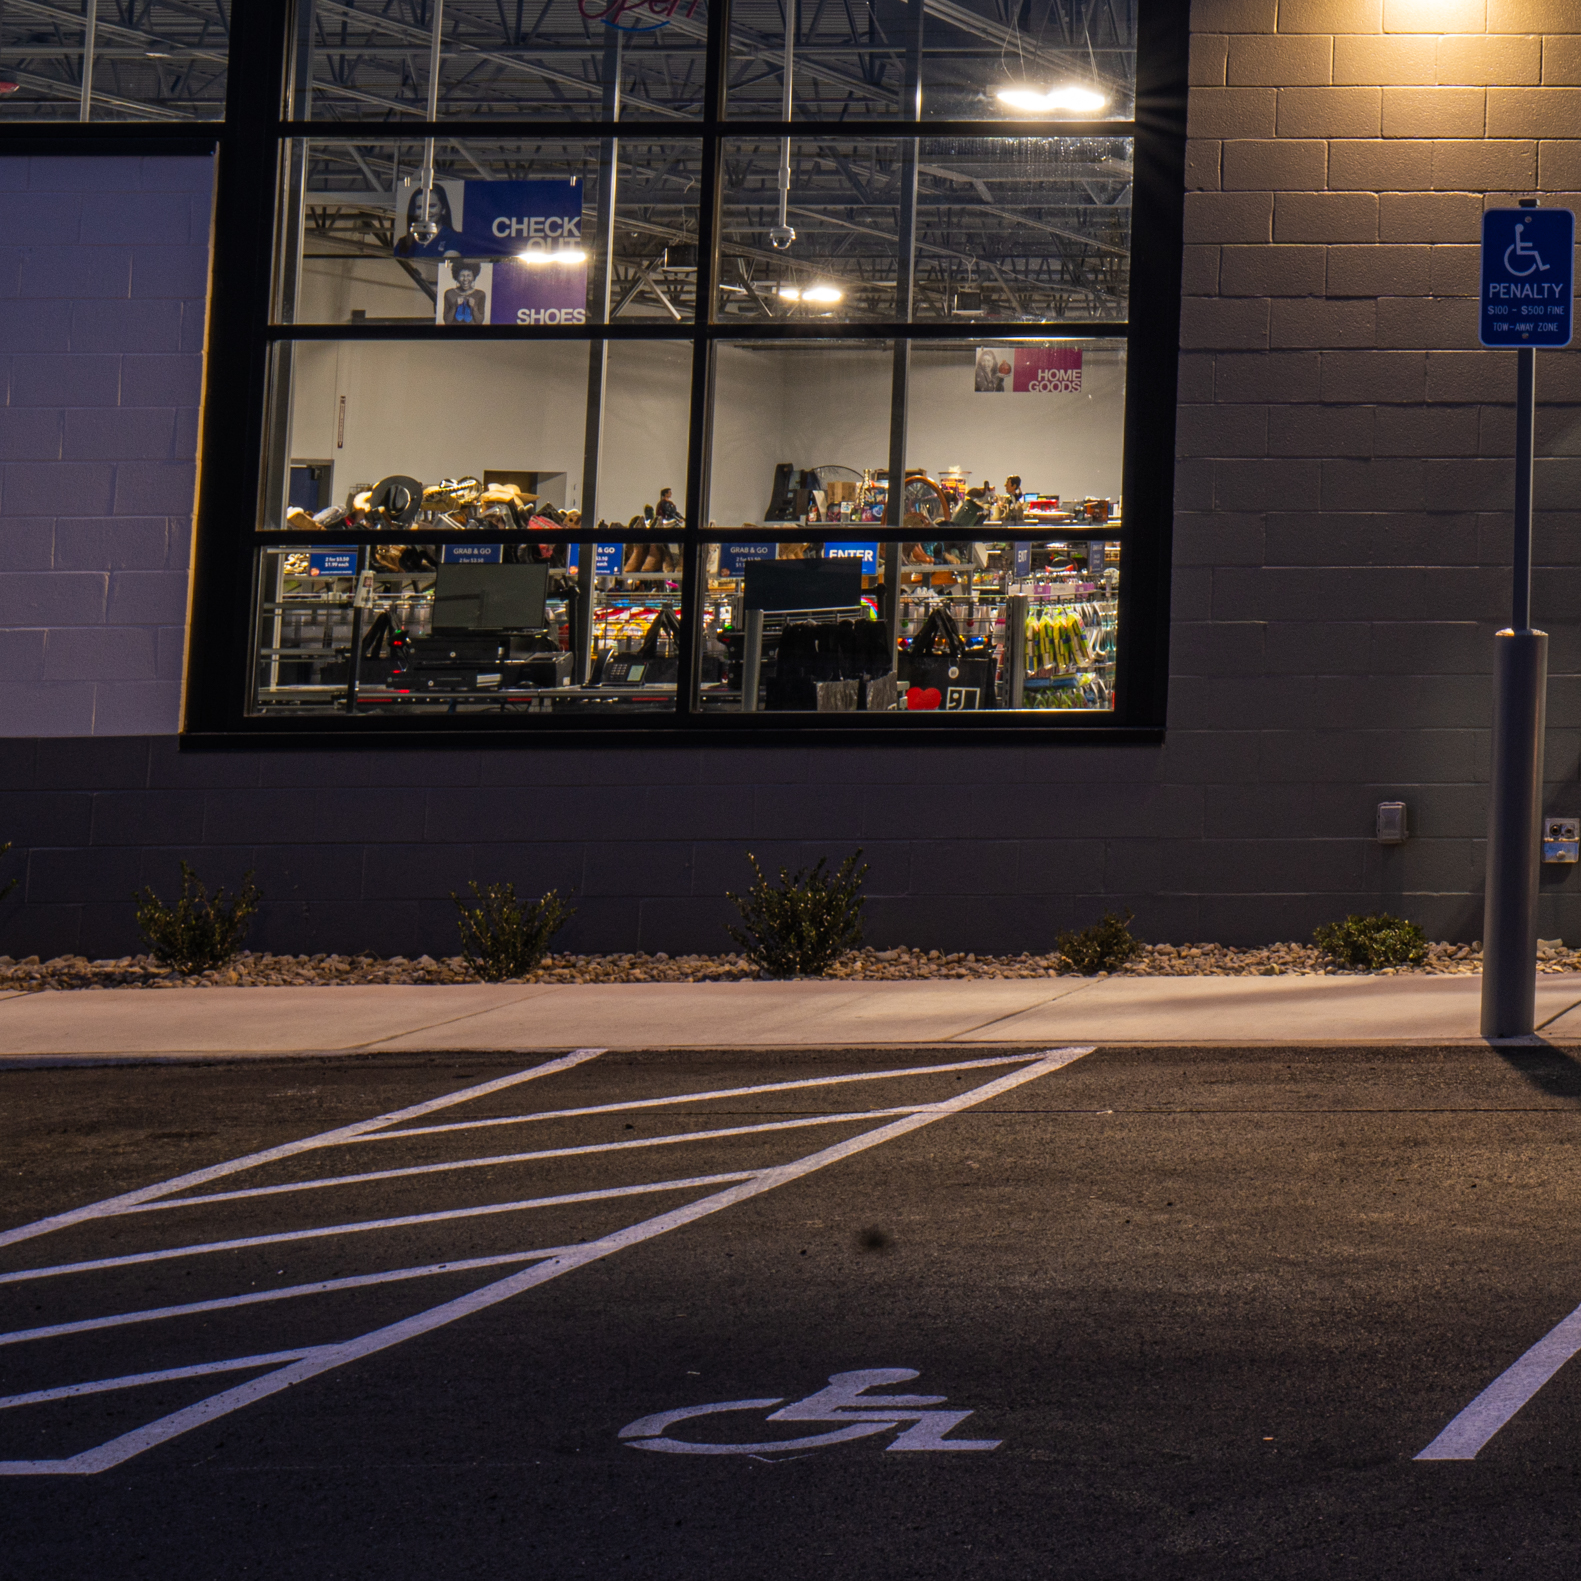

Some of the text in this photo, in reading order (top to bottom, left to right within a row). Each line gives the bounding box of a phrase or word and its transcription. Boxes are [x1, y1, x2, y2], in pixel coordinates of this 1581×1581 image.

[491, 216, 581, 238] CHECK
[1489, 283, 1563, 298] PENALTY
[516, 308, 586, 325] SHOES
[1488, 306, 1508, 315] $100
[1521, 306, 1544, 315] $500
[1547, 306, 1565, 315] FINE
[1493, 322, 1558, 332] TOW-AWAY ZONE
[1038, 369, 1081, 381] HOME
[1029, 381, 1081, 393] GOODS
[829, 549, 873, 562] ENTER
